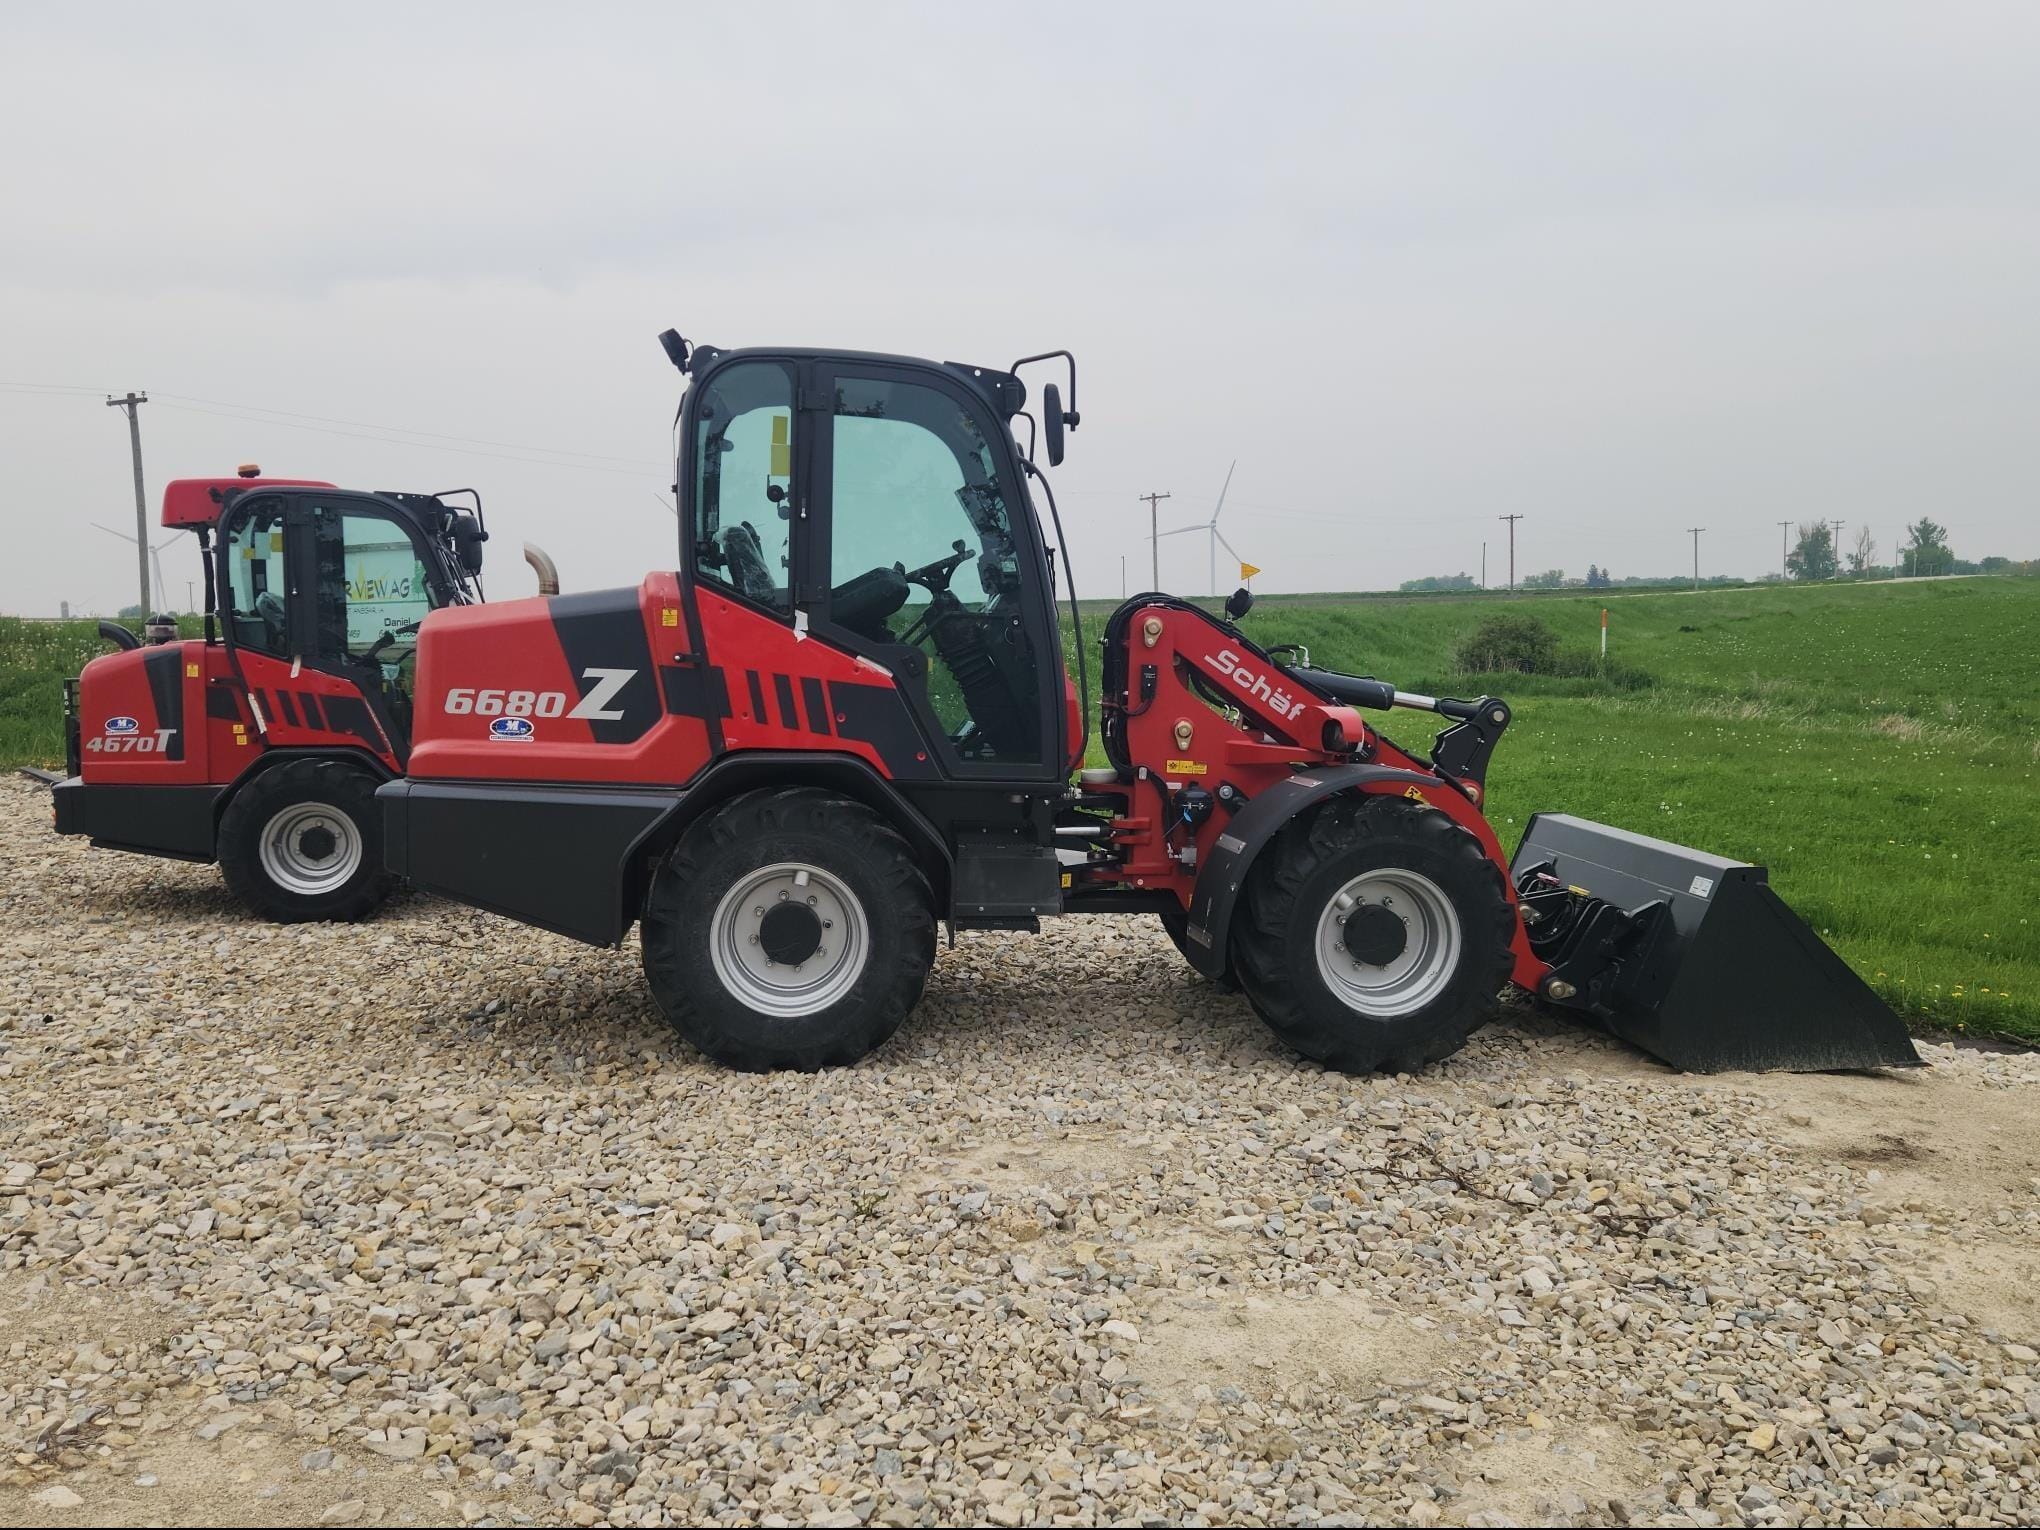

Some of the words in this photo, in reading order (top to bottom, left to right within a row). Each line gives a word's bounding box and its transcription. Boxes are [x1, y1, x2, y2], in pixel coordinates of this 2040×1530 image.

[390, 578, 410, 598] AG
[384, 617, 411, 627] Daniel
[1204, 650, 1306, 720] Schäf
